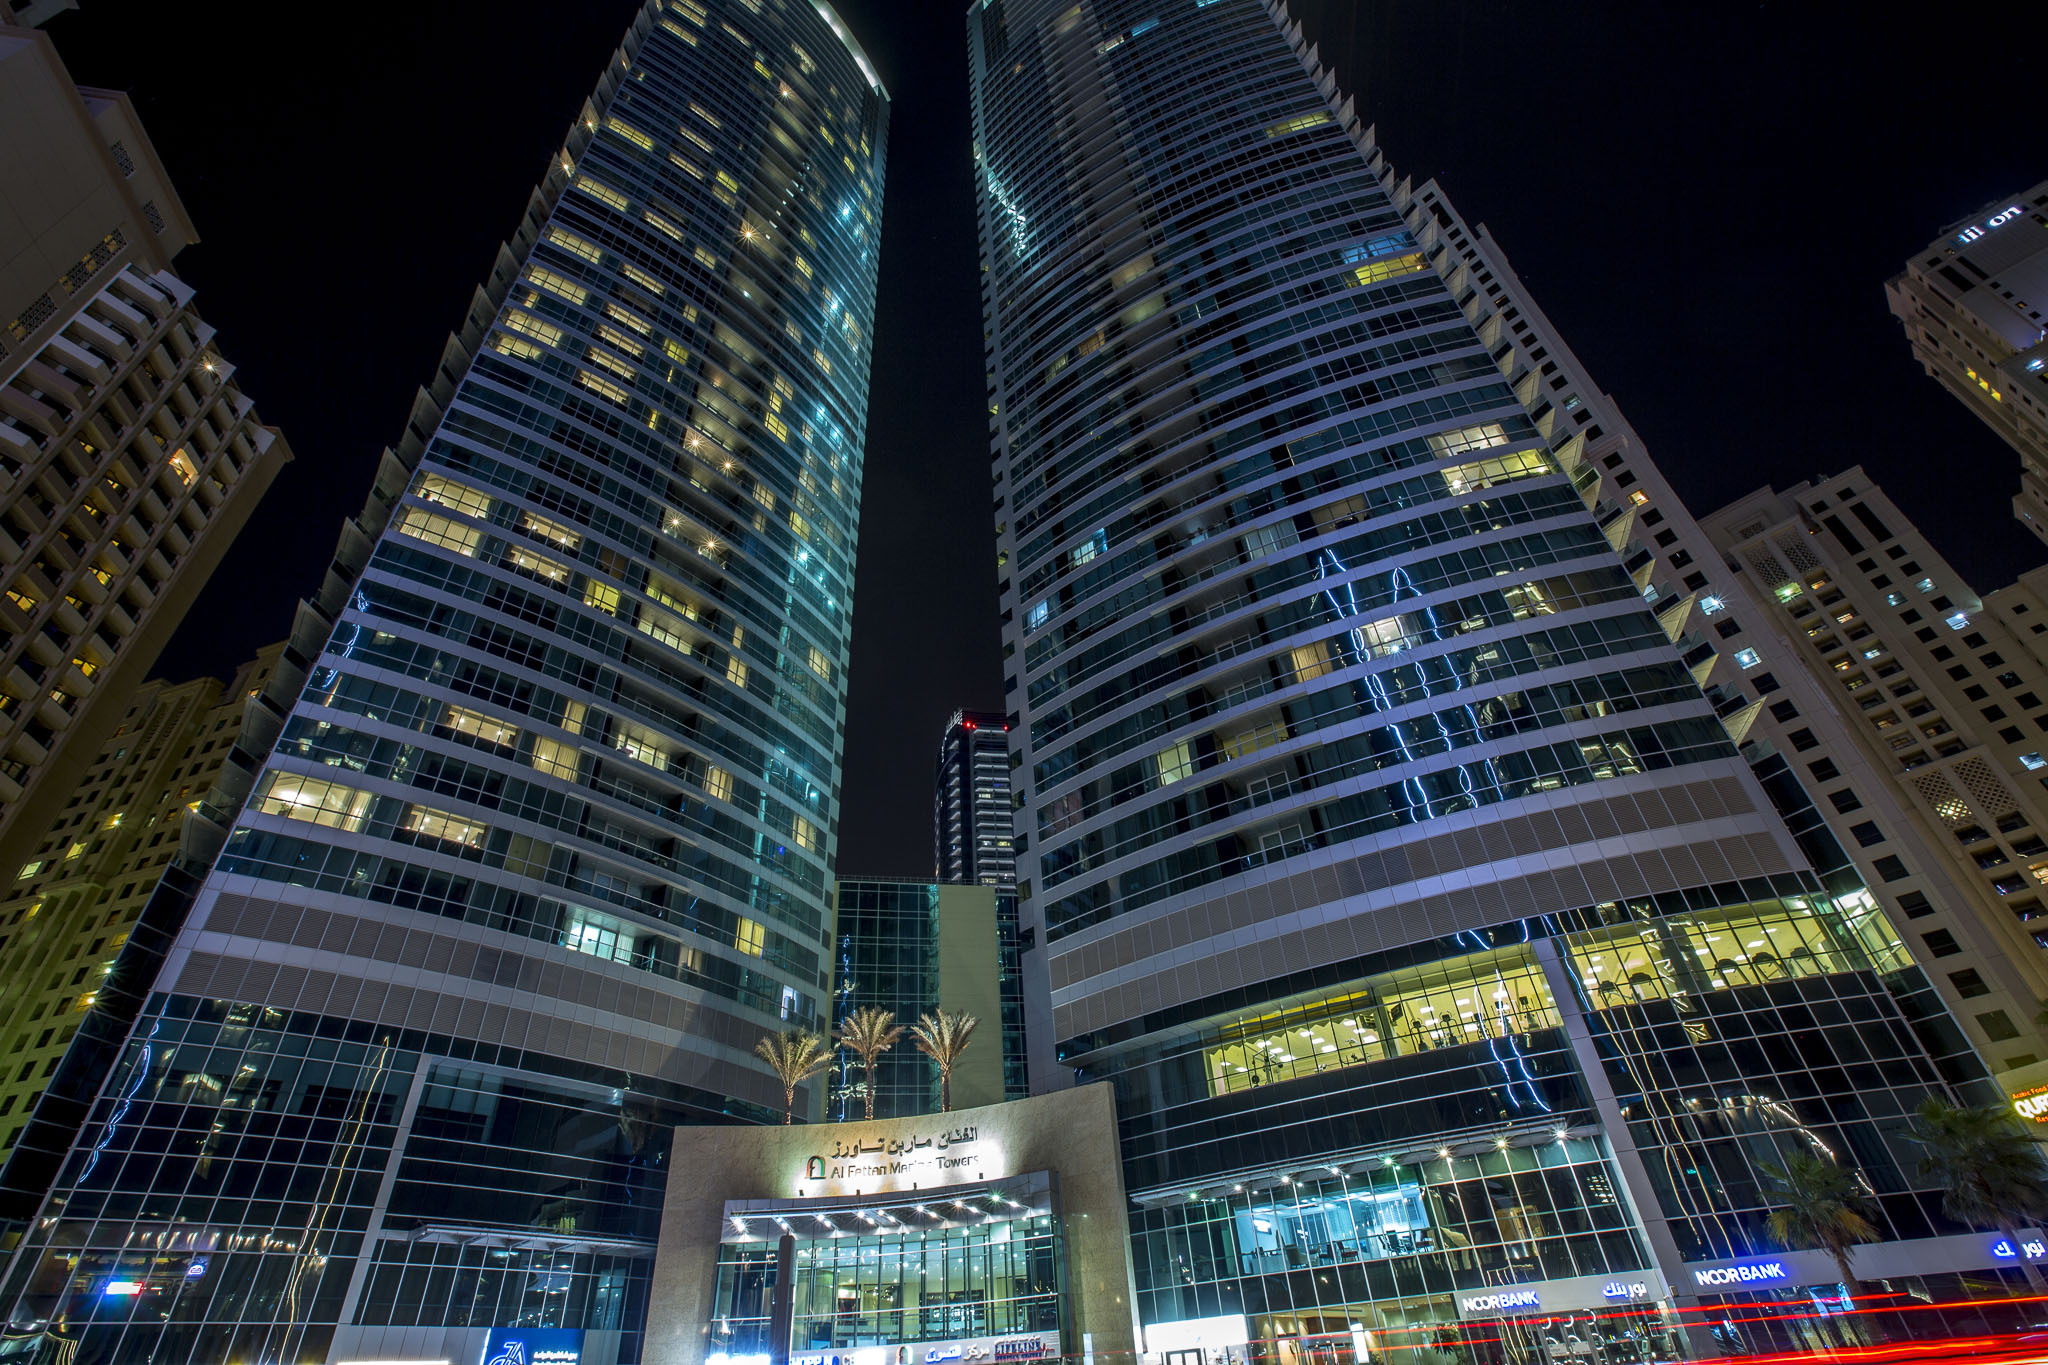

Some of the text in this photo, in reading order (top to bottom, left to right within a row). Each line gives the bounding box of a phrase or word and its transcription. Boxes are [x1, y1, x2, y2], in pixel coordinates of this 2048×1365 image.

[831, 1137, 886, 1160] تاورز
[887, 1134, 933, 1157] مارين
[830, 1165, 844, 1180] Al
[890, 1157, 932, 1176] Mar
[935, 1155, 979, 1170] Towers
[1602, 1280, 1647, 1298] نور بنك
[963, 1342, 990, 1361] مركز
